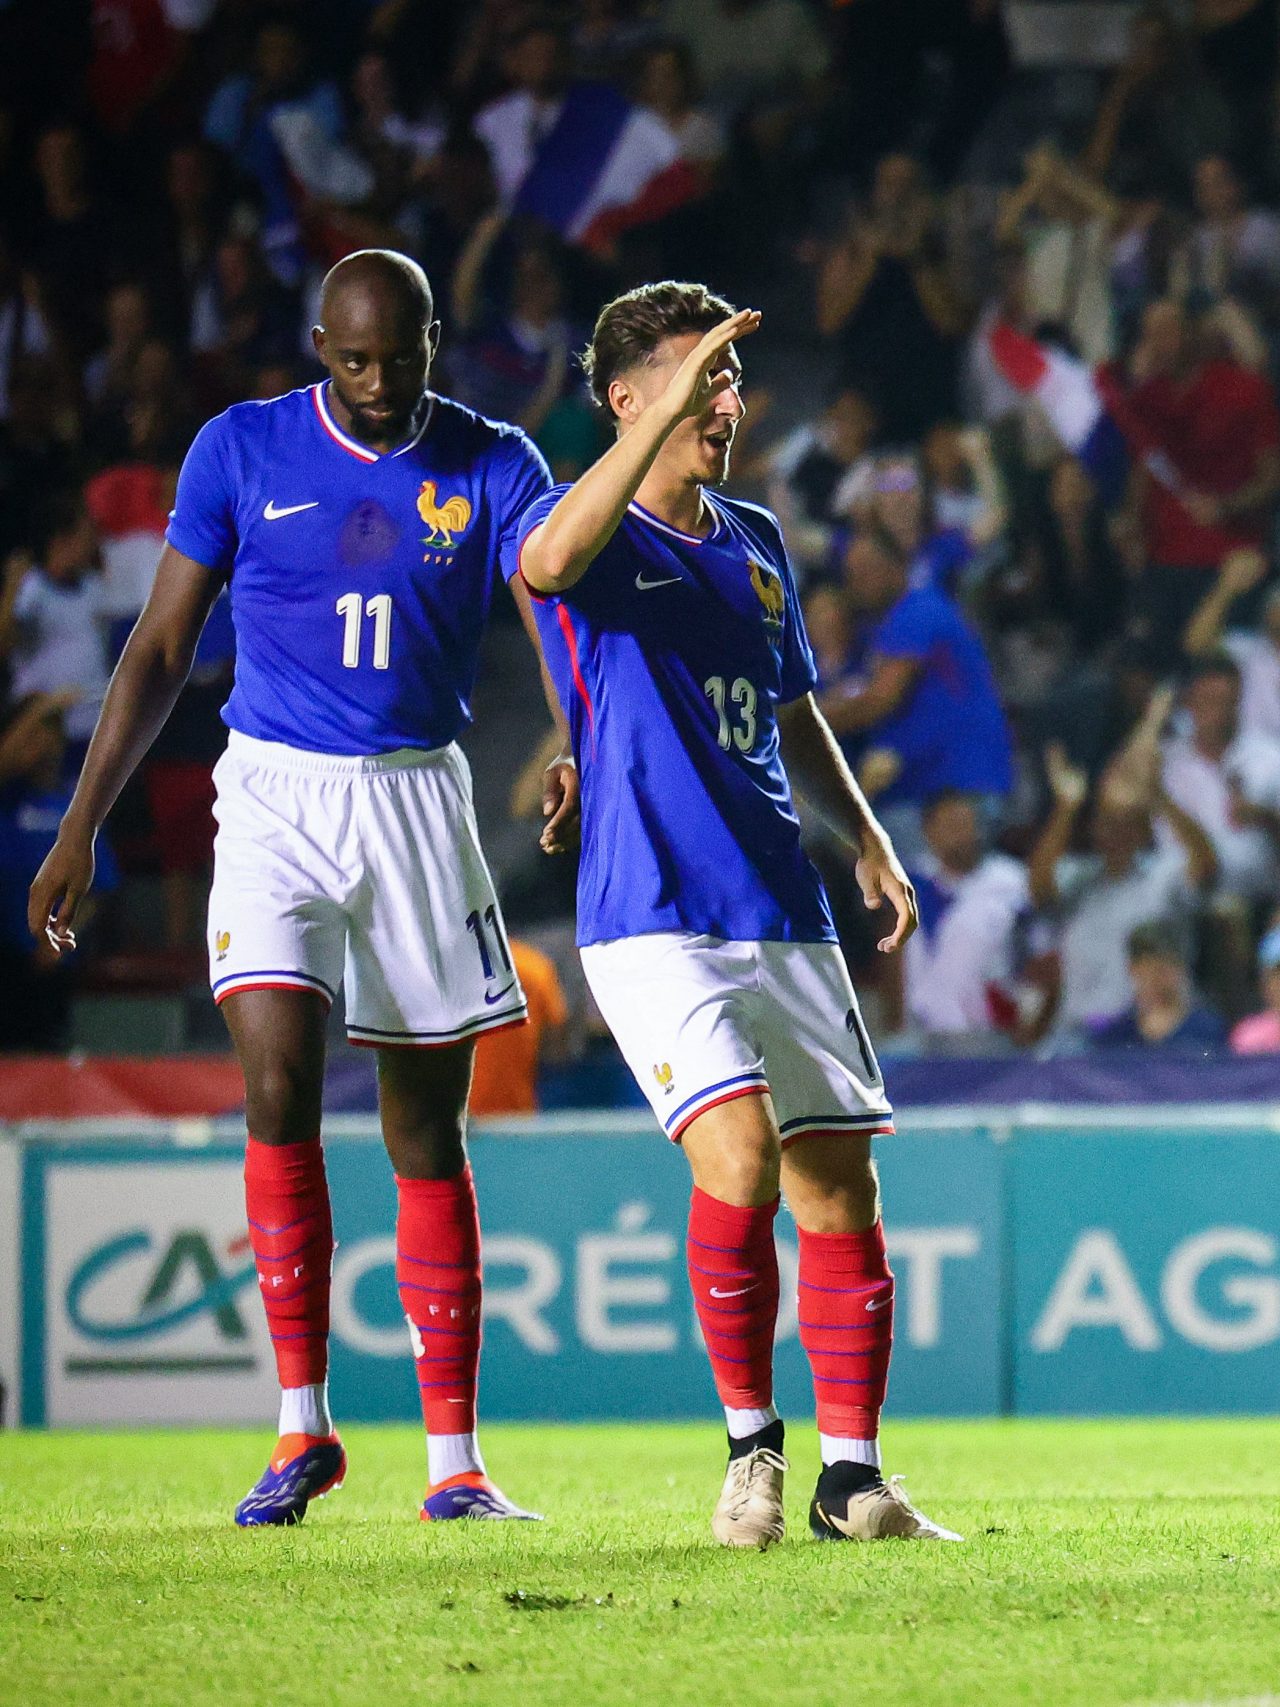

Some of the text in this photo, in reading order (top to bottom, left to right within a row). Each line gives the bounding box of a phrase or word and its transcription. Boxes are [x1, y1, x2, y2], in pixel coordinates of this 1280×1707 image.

[335, 592, 393, 670] 11
[704, 675, 758, 754] 13
[465, 904, 514, 981] 11
[330, 1203, 981, 1358] CRÉT
